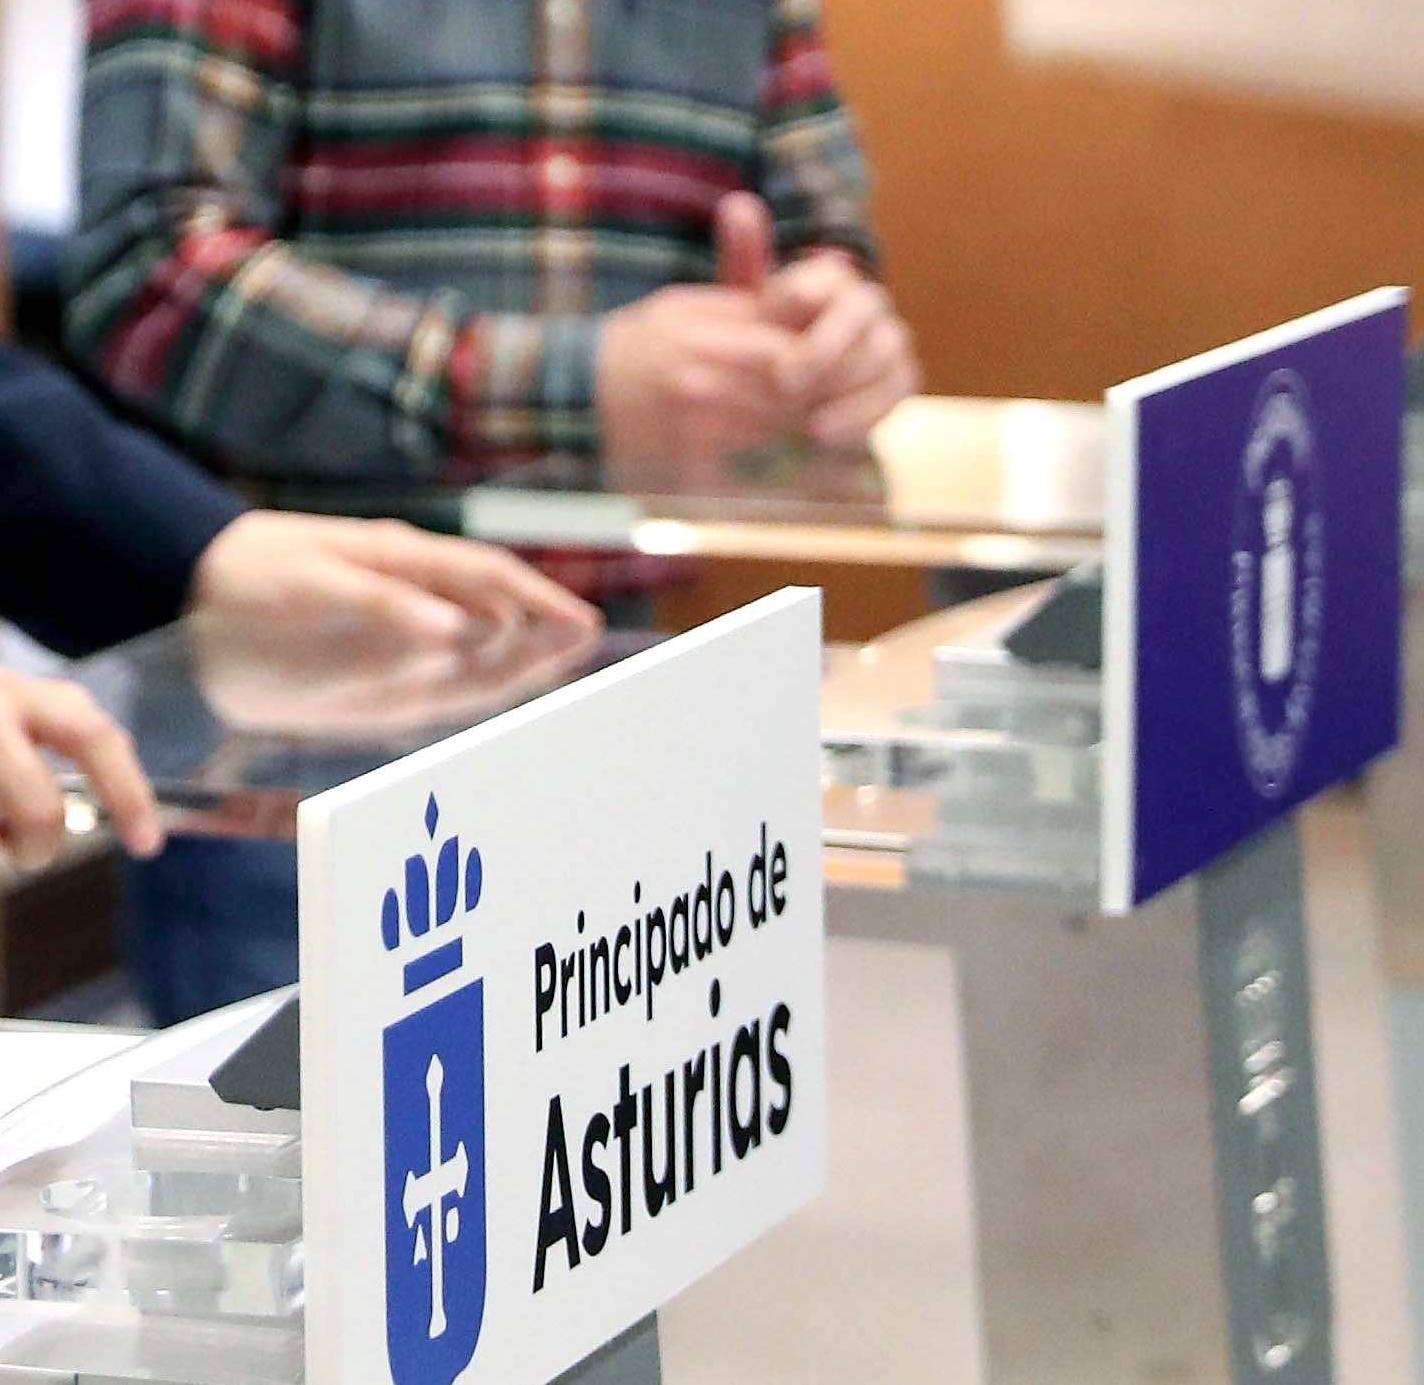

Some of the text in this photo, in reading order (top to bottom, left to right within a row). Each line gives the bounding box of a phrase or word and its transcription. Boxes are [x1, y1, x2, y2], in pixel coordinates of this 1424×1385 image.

[535, 822, 788, 1053] Principado de
[532, 978, 793, 1295] Asturias
